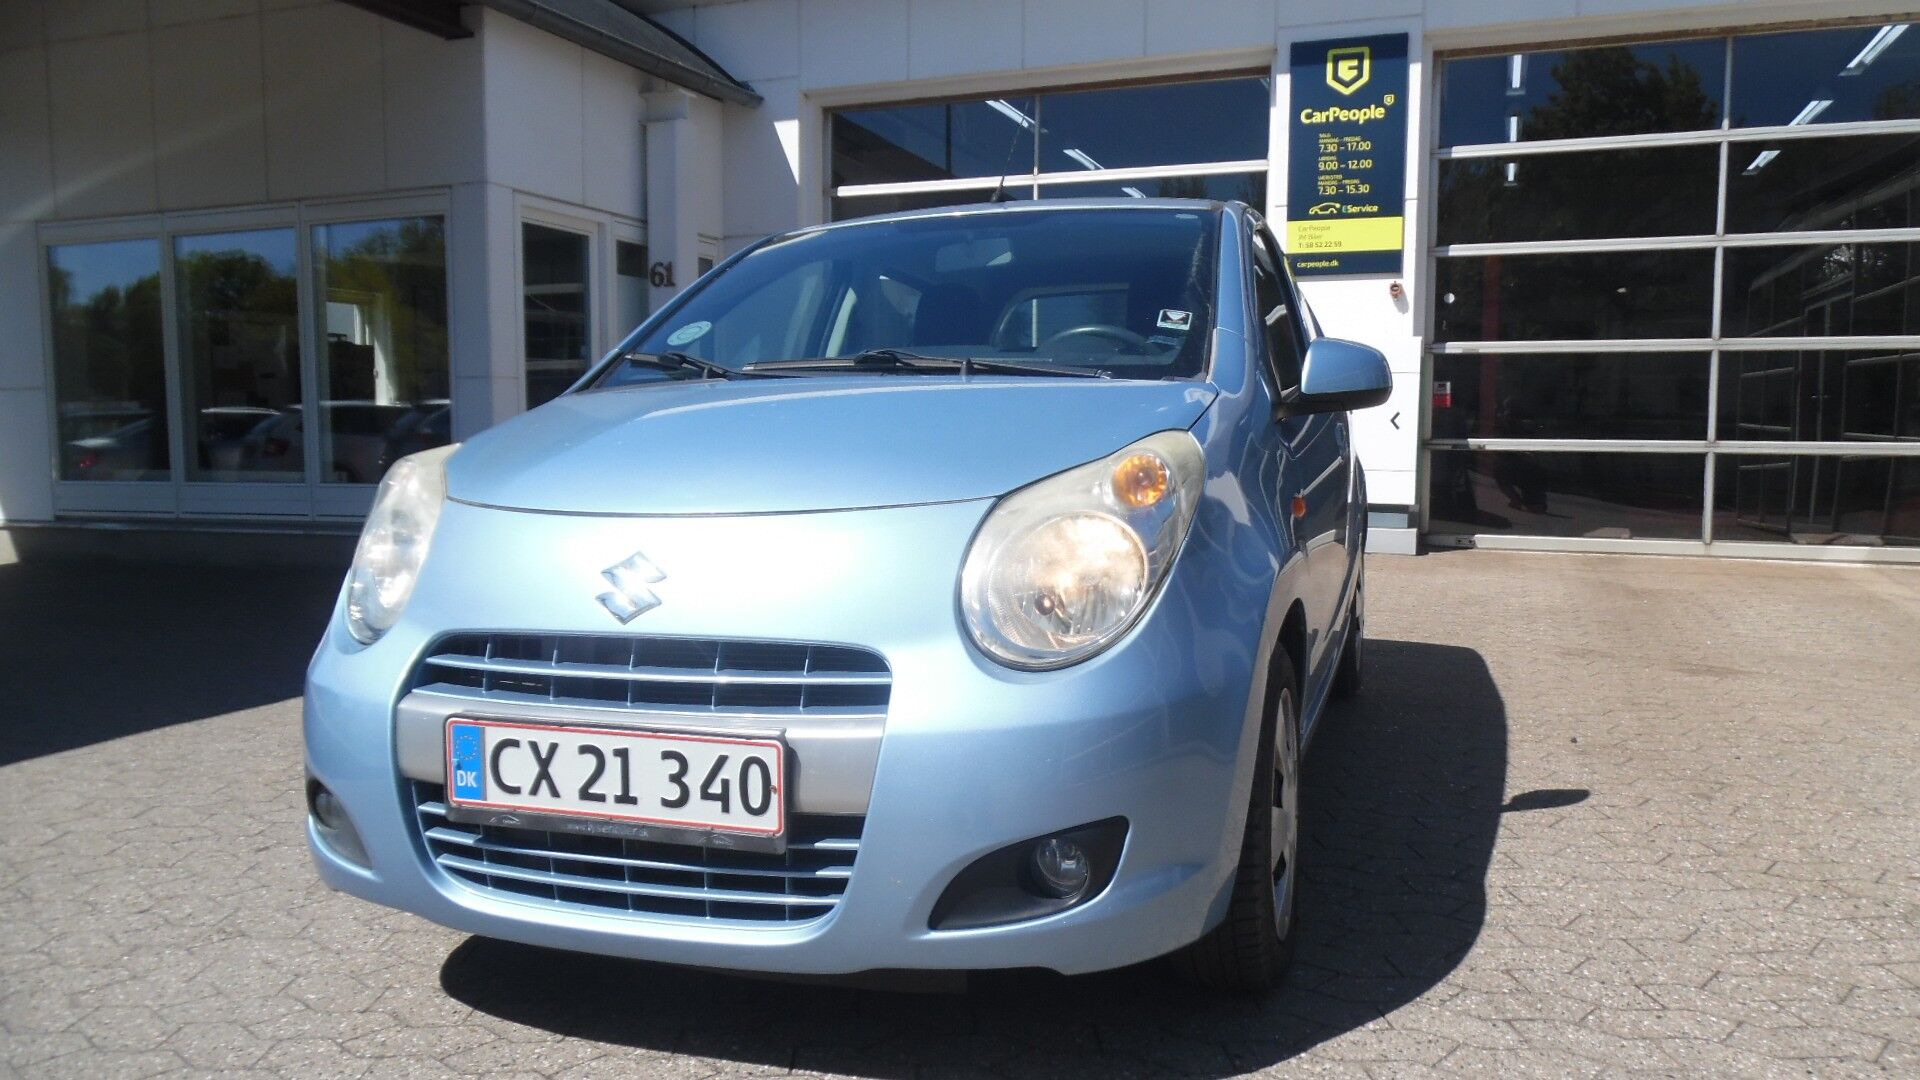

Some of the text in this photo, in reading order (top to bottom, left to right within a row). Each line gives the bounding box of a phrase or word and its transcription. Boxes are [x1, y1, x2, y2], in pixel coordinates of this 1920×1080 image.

[1300, 104, 1386, 124] CarPeople
[1318, 143, 1338, 153] 7.30
[1347, 141, 1371, 151] 17.00
[1318, 161, 1338, 171] 9.00
[1347, 159, 1373, 169] 12.00
[1318, 186, 1337, 195] 7.30
[1346, 184, 1370, 194] 15.30
[1296, 259, 1339, 269] carpeople.dk
[650, 261, 676, 287] 61
[456, 770, 478, 789] DK
[490, 738, 773, 817] CX 21 340
